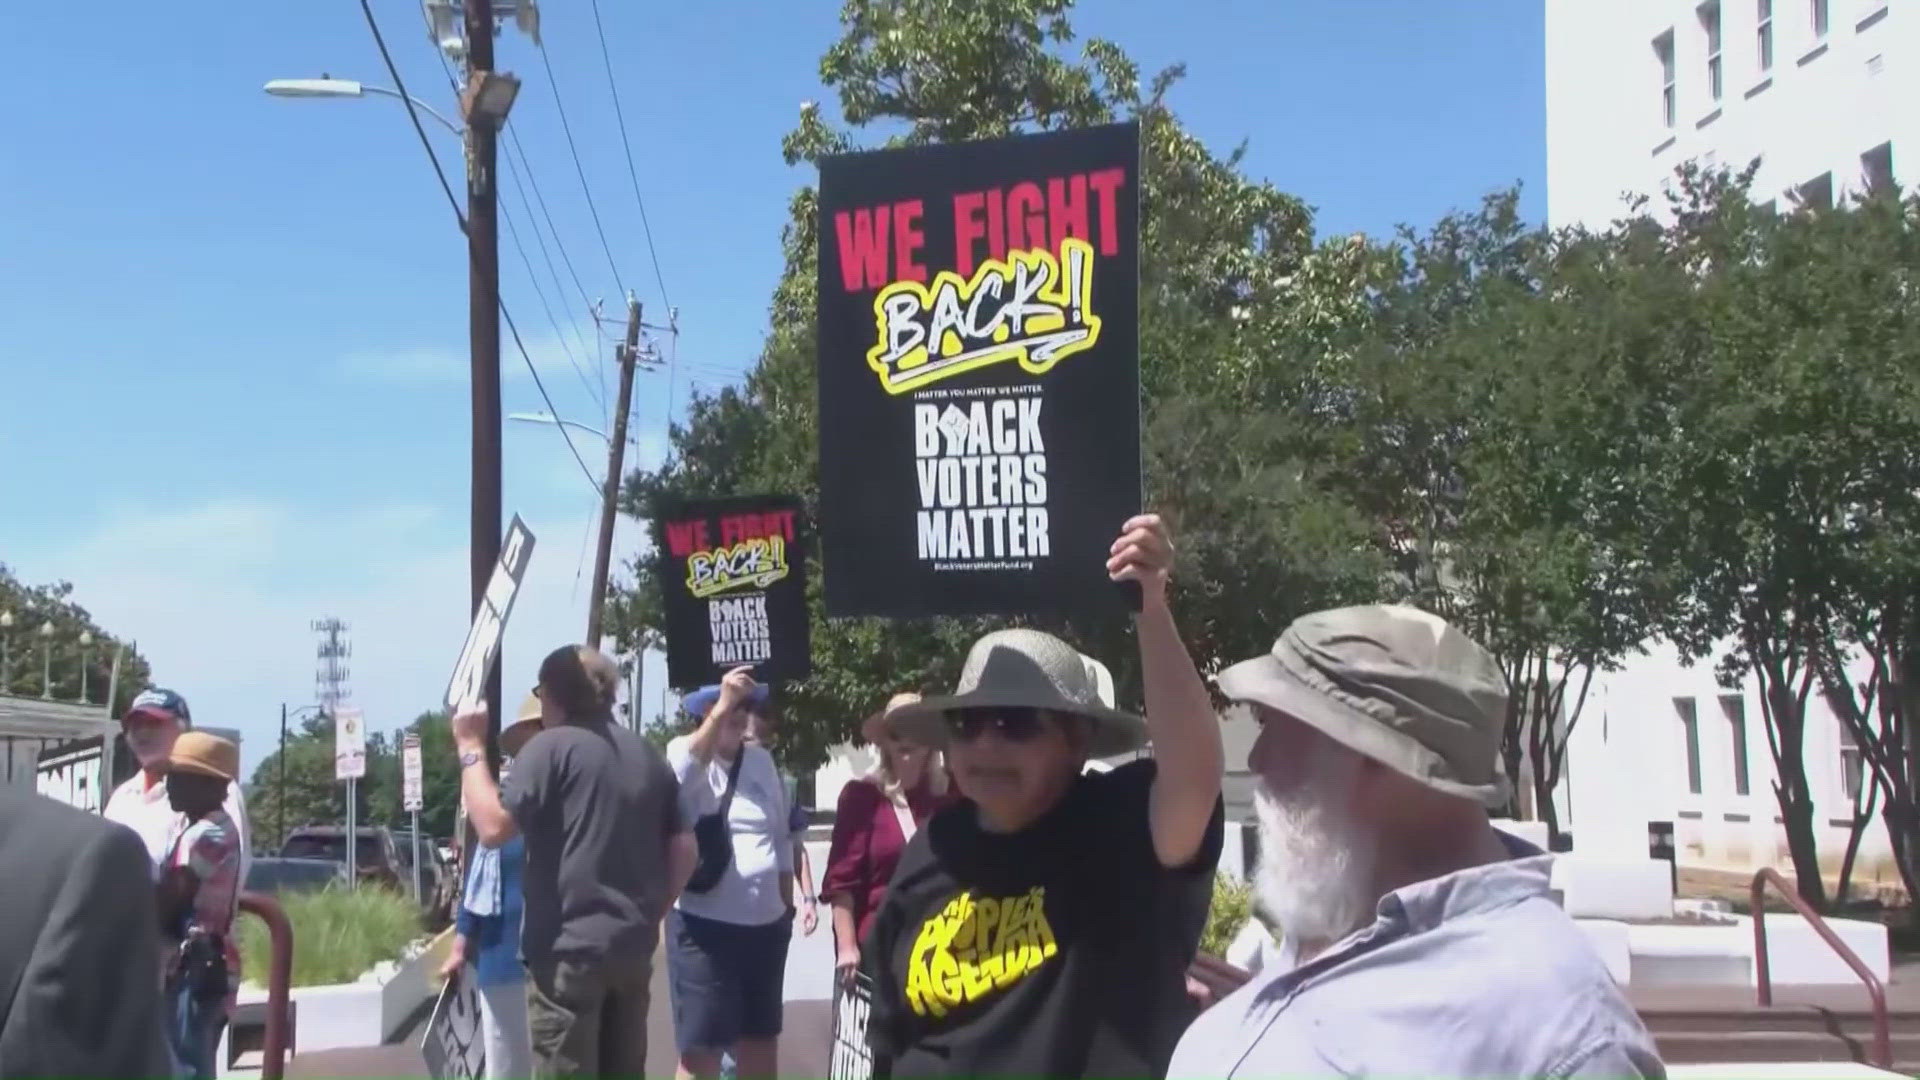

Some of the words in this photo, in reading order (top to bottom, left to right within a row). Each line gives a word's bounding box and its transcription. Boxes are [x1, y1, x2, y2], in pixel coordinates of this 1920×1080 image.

[834, 200, 927, 291] WE
[954, 169, 1125, 276] FIGHT
[880, 246, 1082, 363] BACK!
[916, 454, 1048, 508] VOTERS
[667, 521, 709, 557] WE
[917, 507, 1050, 560] MATTER
[711, 619, 770, 643] VOTERS
[712, 640, 772, 664] MATTER
